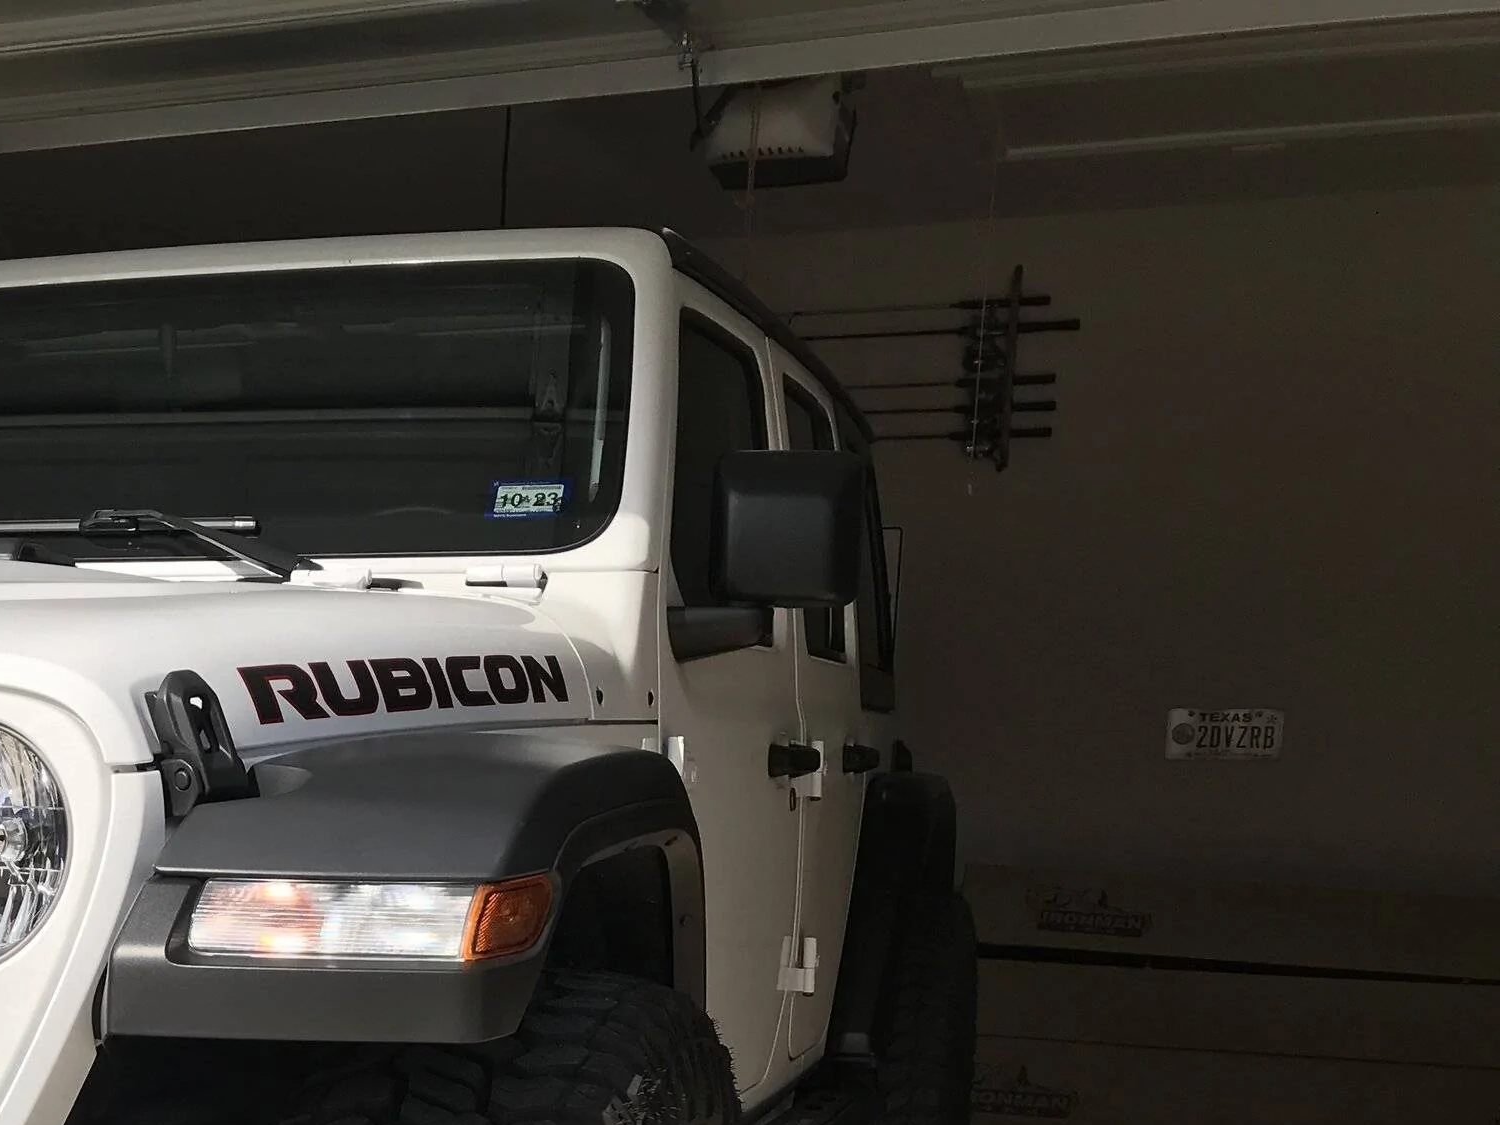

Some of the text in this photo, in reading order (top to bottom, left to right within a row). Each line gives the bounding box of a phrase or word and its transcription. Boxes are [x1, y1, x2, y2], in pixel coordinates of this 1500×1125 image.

[533, 492, 559, 507] 23
[237, 654, 569, 725] RUBICON
[1199, 712, 1253, 723] TEXAS
